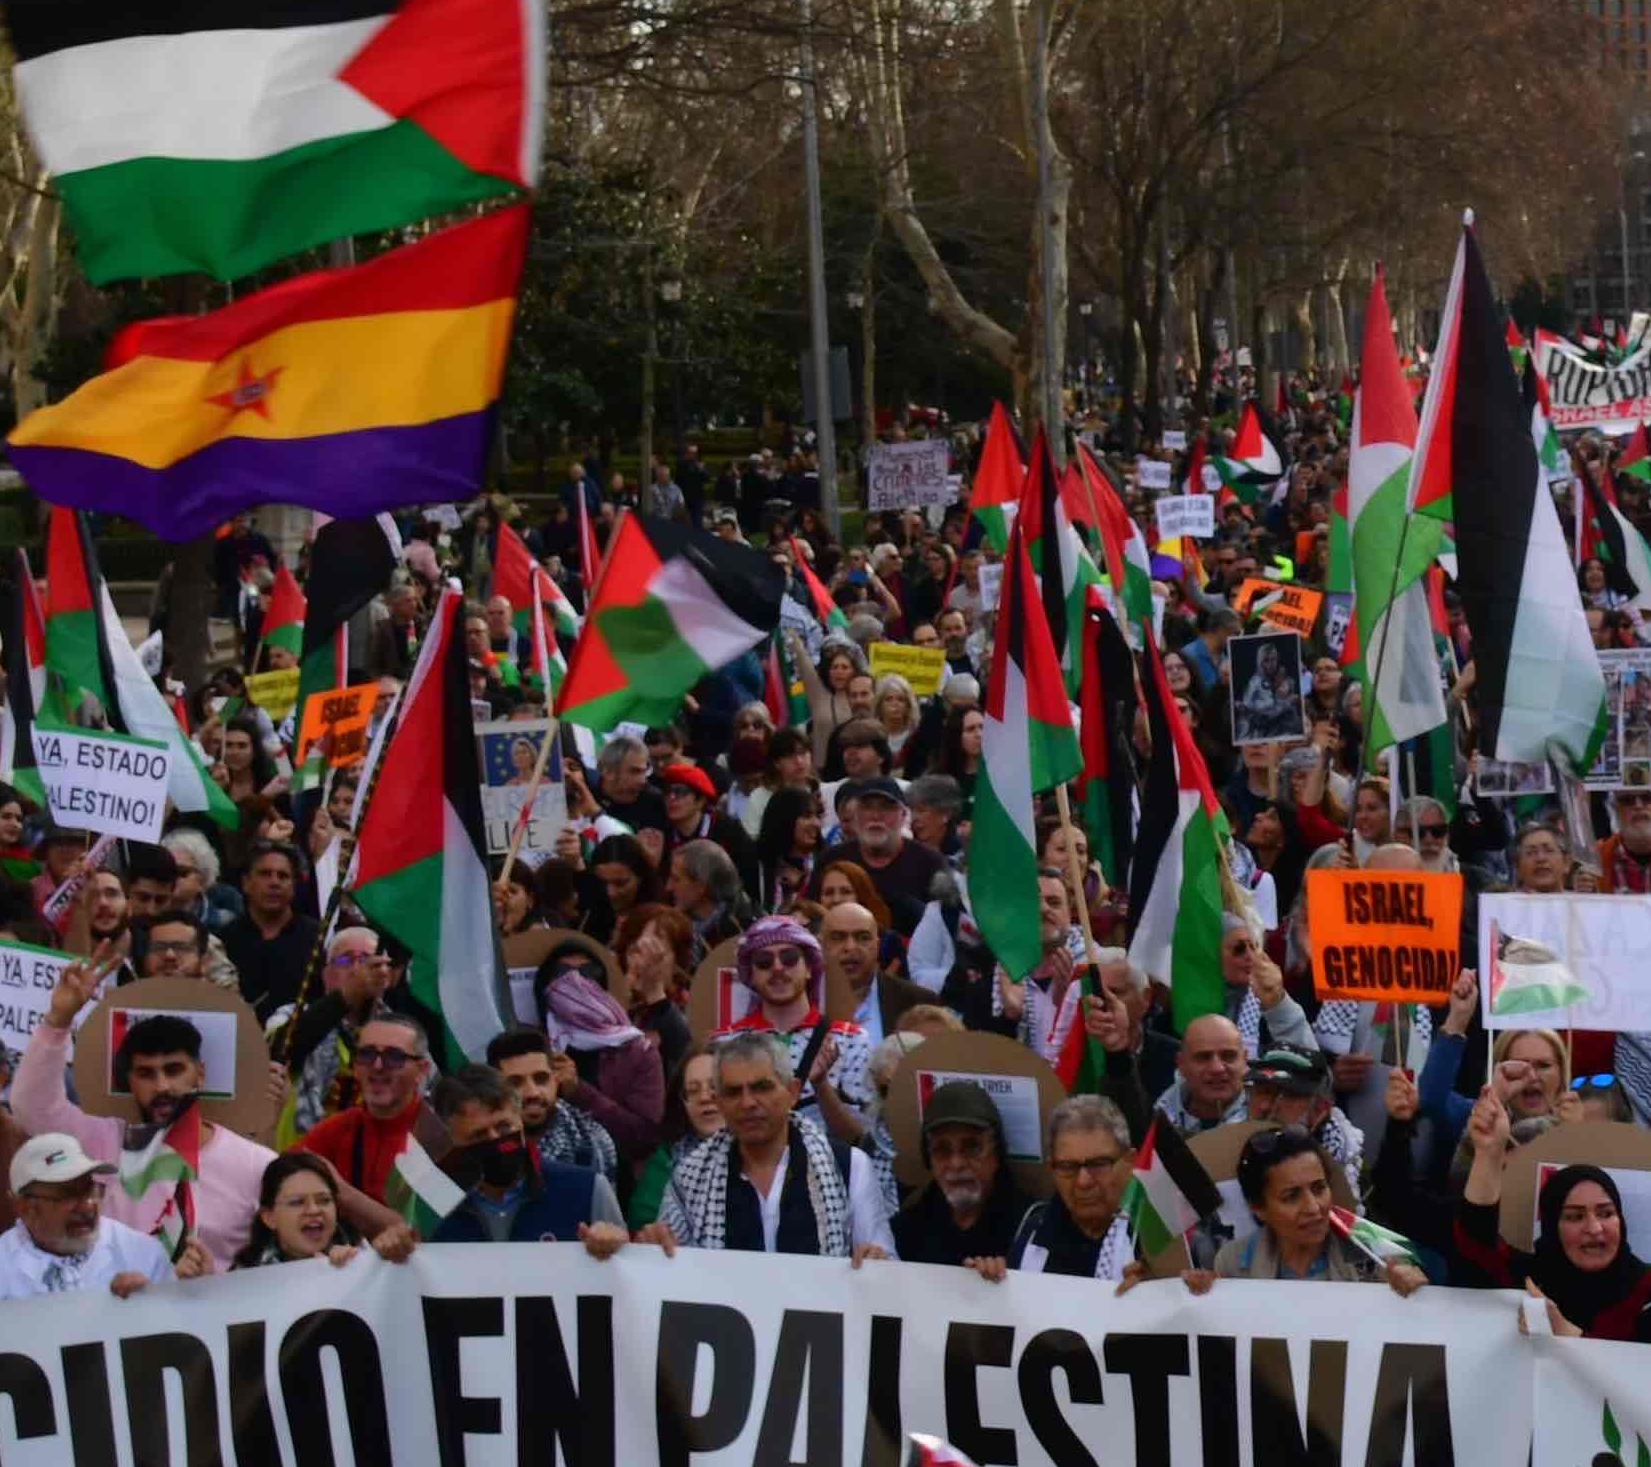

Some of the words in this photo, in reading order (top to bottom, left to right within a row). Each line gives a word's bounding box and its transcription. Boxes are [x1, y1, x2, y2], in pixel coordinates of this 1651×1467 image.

[75, 741, 167, 780] ESTADO
[49, 783, 157, 827] ALESTINO!
[1343, 879, 1435, 930] ISRAEL,
[1322, 944, 1456, 993] GENOCIDA!
